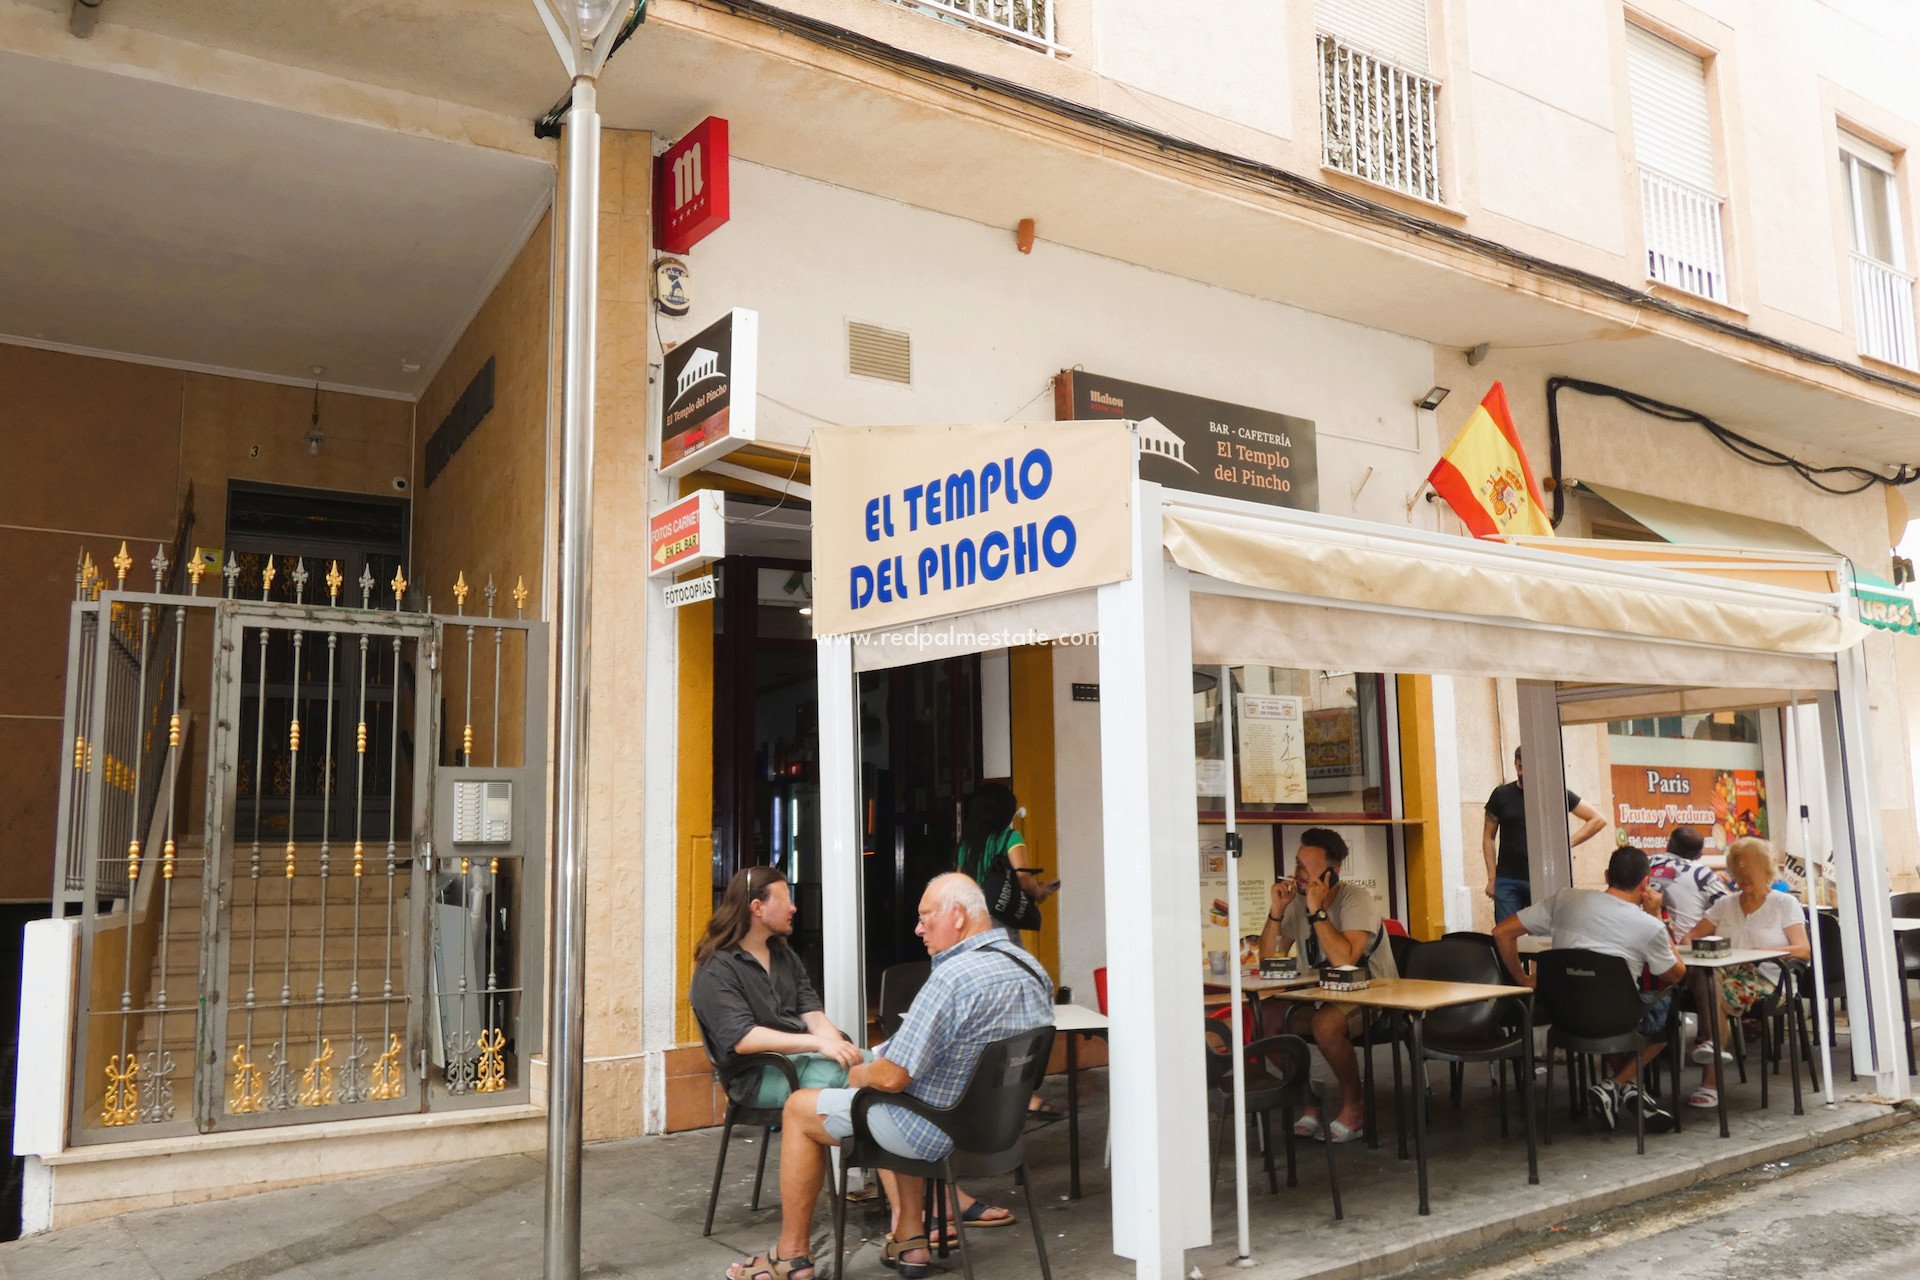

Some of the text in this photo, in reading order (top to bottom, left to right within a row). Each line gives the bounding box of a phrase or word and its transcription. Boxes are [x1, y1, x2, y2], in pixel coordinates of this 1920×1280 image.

[666, 384, 727, 426] El Templo del Pincho
[1090, 390, 1124, 408] Mahou
[1209, 421, 1229, 436] BAR
[1238, 428, 1292, 448] CAFETERÍA
[250, 445, 259, 457] 3
[1217, 441, 1290, 469] El Templo
[1214, 464, 1291, 492] del Pincho
[865, 448, 1053, 542] EL TEMPLO
[651, 510, 700, 543] FOTOS CARNET
[665, 535, 697, 558] EN EL BAR
[850, 514, 1077, 610] DEL PINCHO
[1647, 770, 1690, 794] Paris
[1618, 803, 1716, 828] Frutas y Verduras
